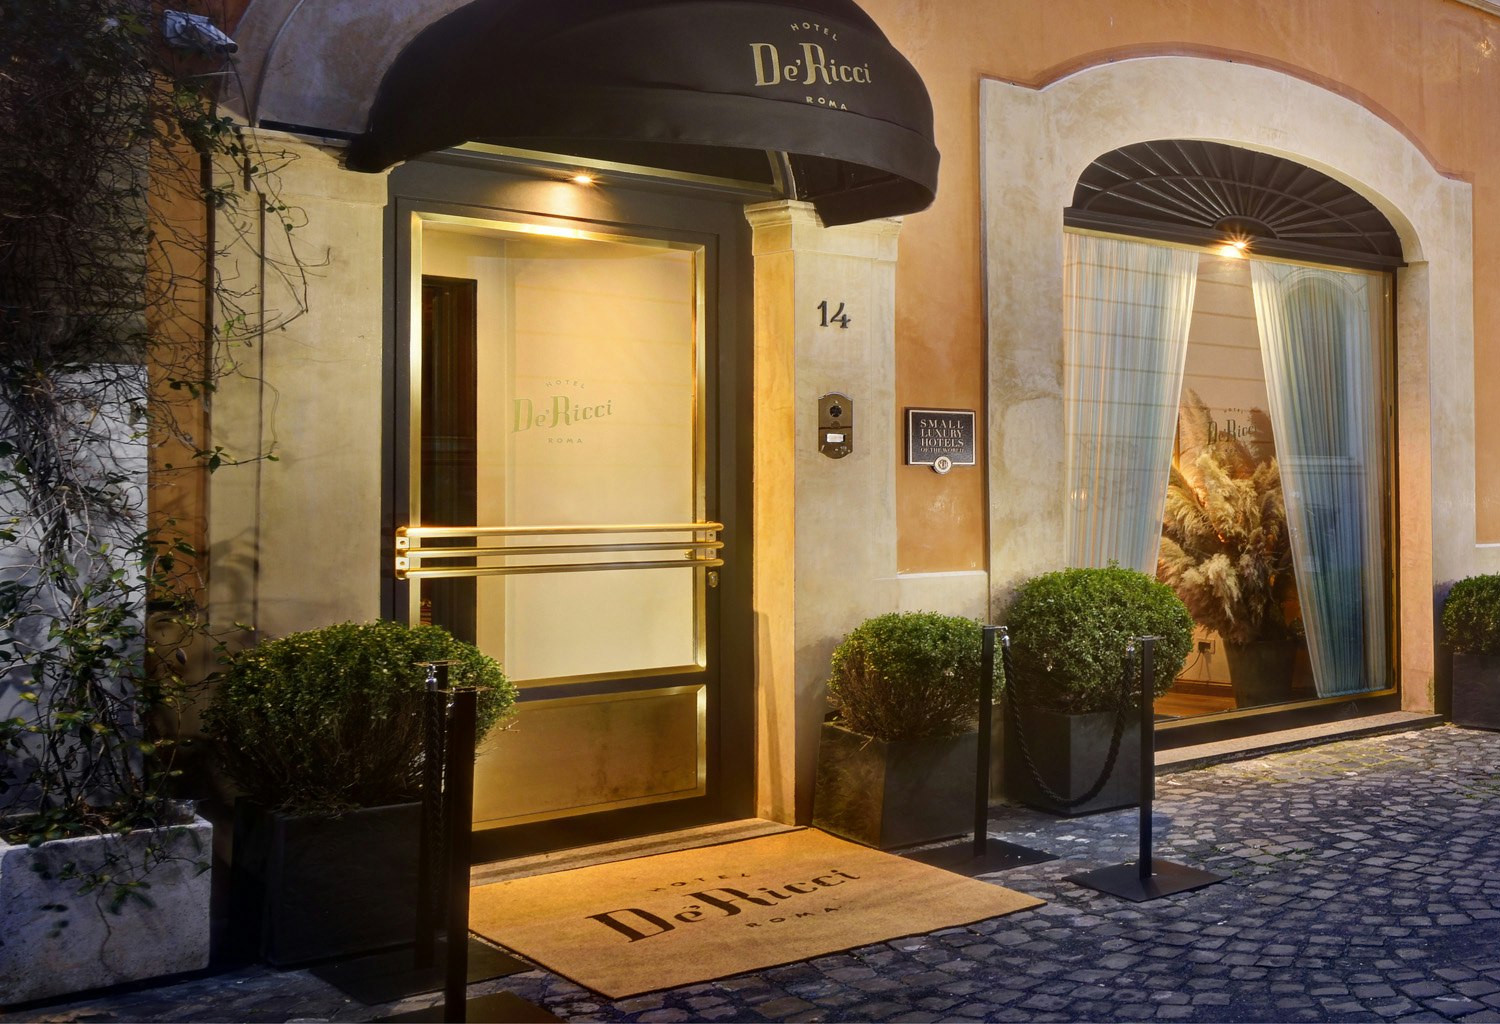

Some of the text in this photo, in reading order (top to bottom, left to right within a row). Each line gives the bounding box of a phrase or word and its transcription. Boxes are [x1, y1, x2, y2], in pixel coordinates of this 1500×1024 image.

[790, 22, 838, 42] HOTEL
[805, 95, 848, 111] ROMA
[817, 300, 851, 329] 14
[545, 379, 585, 389] HOTEL
[920, 419, 964, 428] SMALL
[921, 428, 962, 438] LUXURY
[921, 438, 964, 447] HOTELS
[650, 873, 750, 892] HOTEL
[745, 905, 842, 928] ROMA
